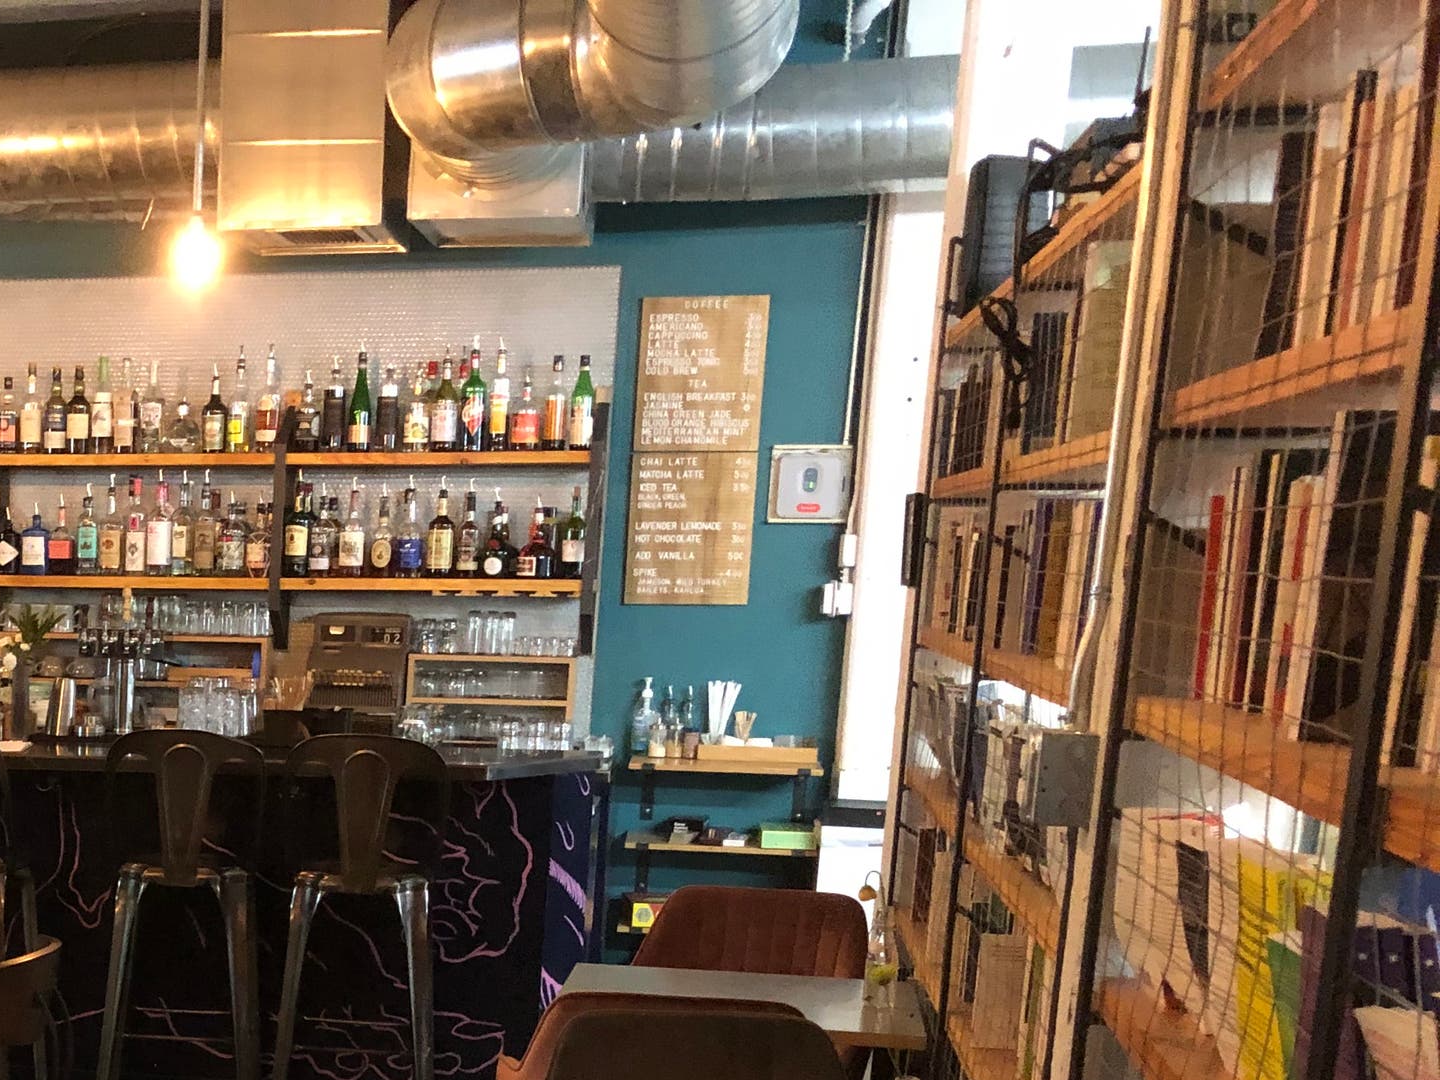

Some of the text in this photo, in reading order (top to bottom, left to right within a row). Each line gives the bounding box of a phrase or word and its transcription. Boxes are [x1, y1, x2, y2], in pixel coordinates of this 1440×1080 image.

[684, 300, 729, 309] COFFEE
[649, 313, 699, 322] ESPRESSO
[649, 322, 703, 331] AMERICANO
[648, 331, 708, 340] CAPPUCCINO
[647, 340, 679, 349] LATTE
[647, 348, 716, 358] MOCHA LATTE
[645, 366, 698, 375] COLD BREW
[688, 379, 707, 388] TEA
[643, 392, 683, 401] ENGLISH
[686, 391, 736, 401] BREAKFAST
[643, 401, 683, 410] JASMINE
[643, 410, 731, 418] CHINA GREEN JADE
[642, 418, 669, 427] BLOOD
[671, 418, 706, 428] ORANGE
[641, 427, 744, 436] MEDITERRANEAN MINT
[641, 436, 728, 445] LEMON CHAMOMILE
[640, 457, 698, 466] CHAI LATTE
[640, 470, 672, 479] MATCHA
[676, 470, 704, 479] LATTE
[640, 482, 657, 492] ICED
[662, 482, 677, 492] TEA
[635, 521, 677, 530] LAVENDER
[681, 521, 721, 530] LEMONADE
[635, 535, 651, 544] HOT
[654, 534, 702, 543] CHOCOLATE
[635, 551, 651, 560] ADD
[658, 551, 695, 560] VANILLA
[633, 568, 657, 577] SPIKE
